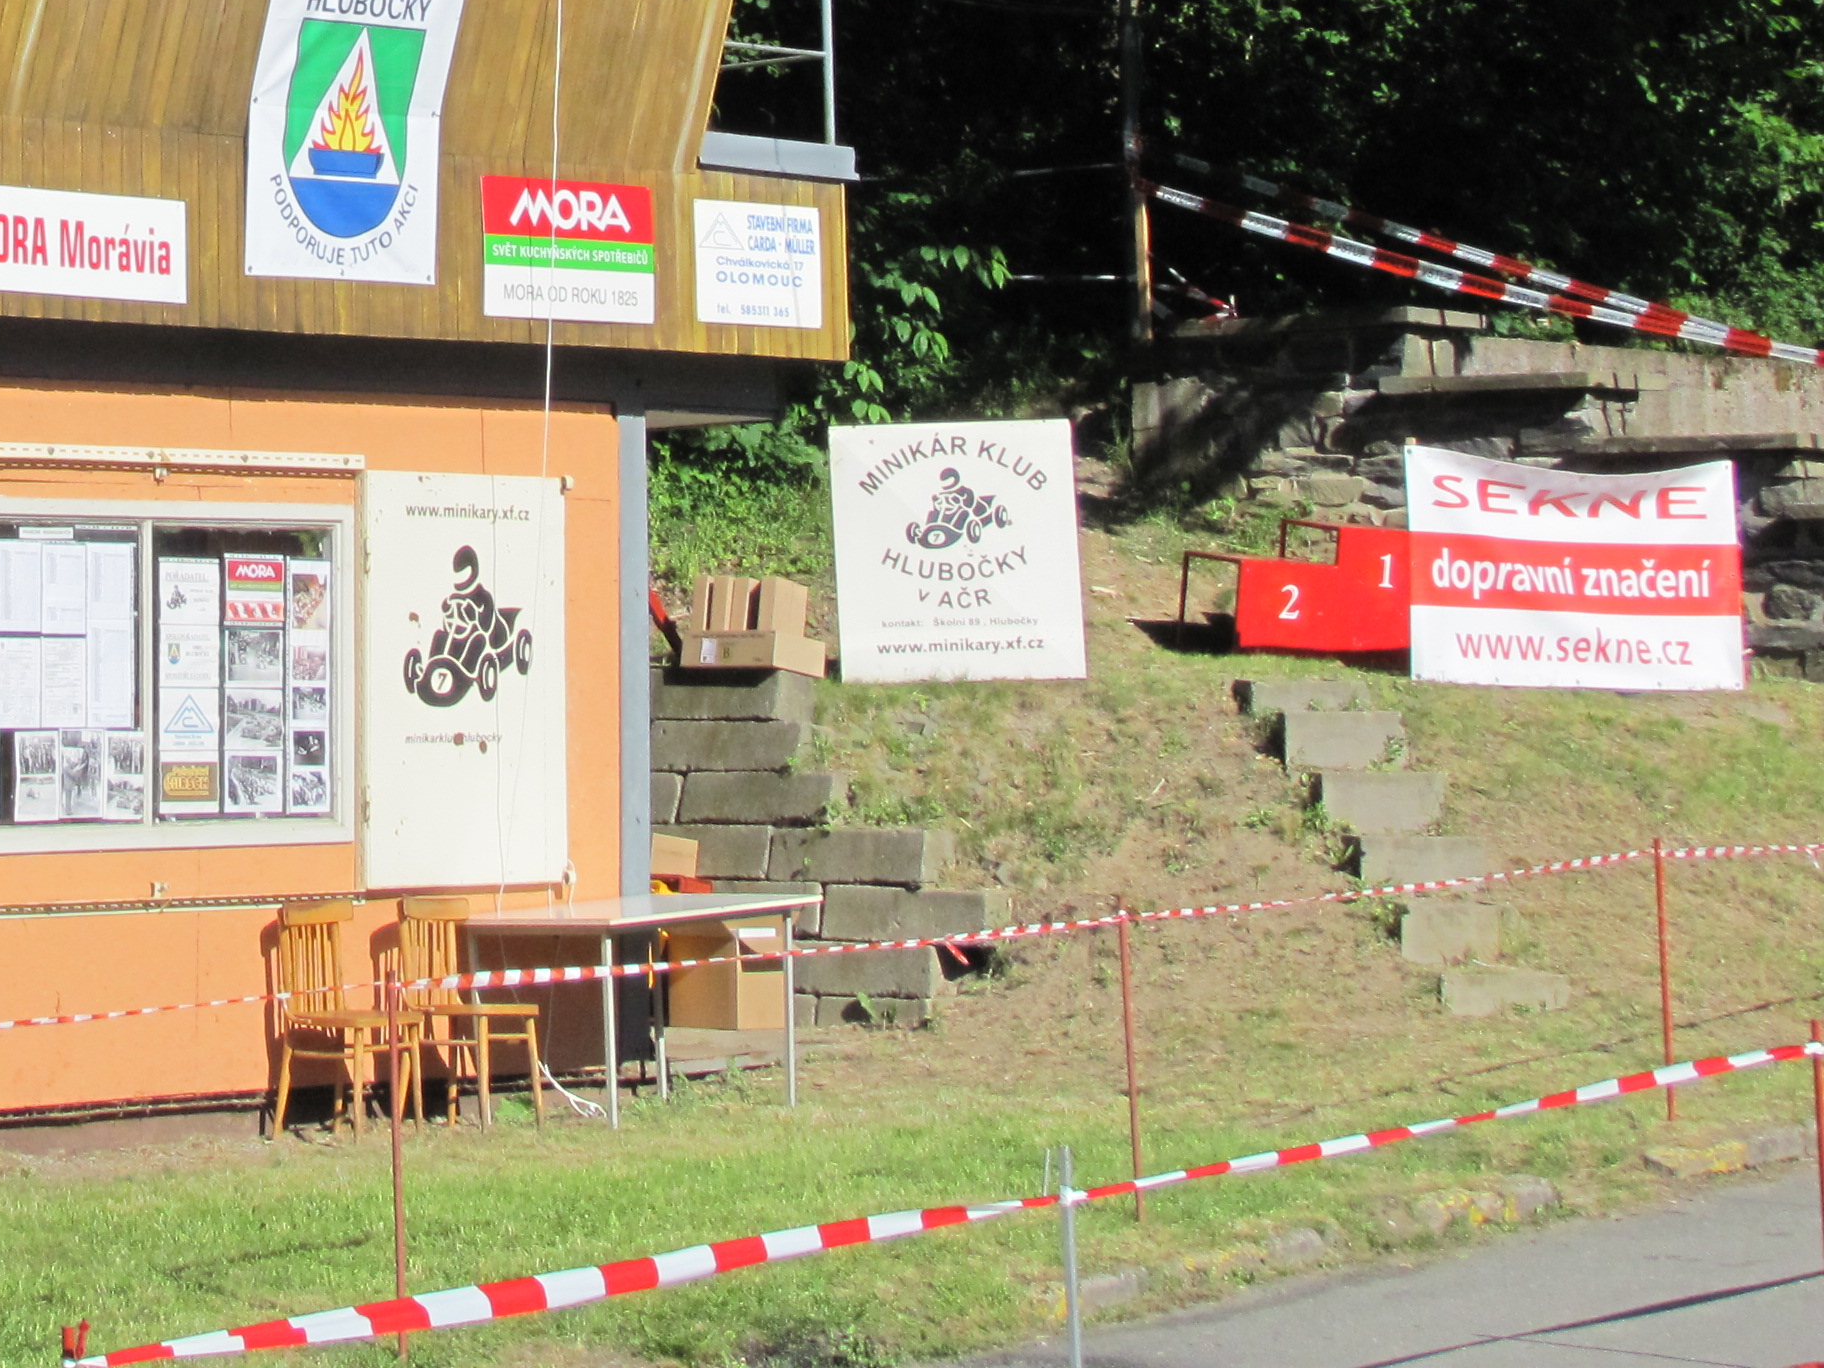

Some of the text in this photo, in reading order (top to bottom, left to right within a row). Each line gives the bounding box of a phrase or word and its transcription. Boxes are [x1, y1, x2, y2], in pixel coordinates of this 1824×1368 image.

[270, 173, 419, 265] PODPORUJE TUTO AKCI
[509, 187, 632, 234] MORA
[786, 217, 814, 235] FIRMA
[59, 219, 172, 276] Morávia
[492, 241, 649, 266] SVĚT KUCHYŇSKÝCH SPOTŘEBIČŮ
[747, 235, 816, 255] CARDA MÜLLER
[794, 261, 804, 271] 17
[716, 270, 804, 288] OLOMOUC
[503, 283, 639, 307] MORA OD ROKU 1825
[858, 432, 1048, 496] MINIKÁR KLUB
[1431, 474, 1708, 520] SEKNE
[405, 503, 531, 525] www.minikary.xf.cz
[235, 563, 276, 579] MORA
[881, 545, 1028, 582] HLUBOČKY
[1378, 553, 1393, 589] 1
[1431, 547, 1710, 600] dopravní značení
[938, 586, 992, 609] AČR
[1278, 584, 1300, 620] 2
[876, 635, 1044, 655] www.minikary.xf.cz
[1454, 626, 1693, 666] www.sekne.cz
[438, 673, 448, 691] 7
[405, 733, 457, 744] minikarklu
